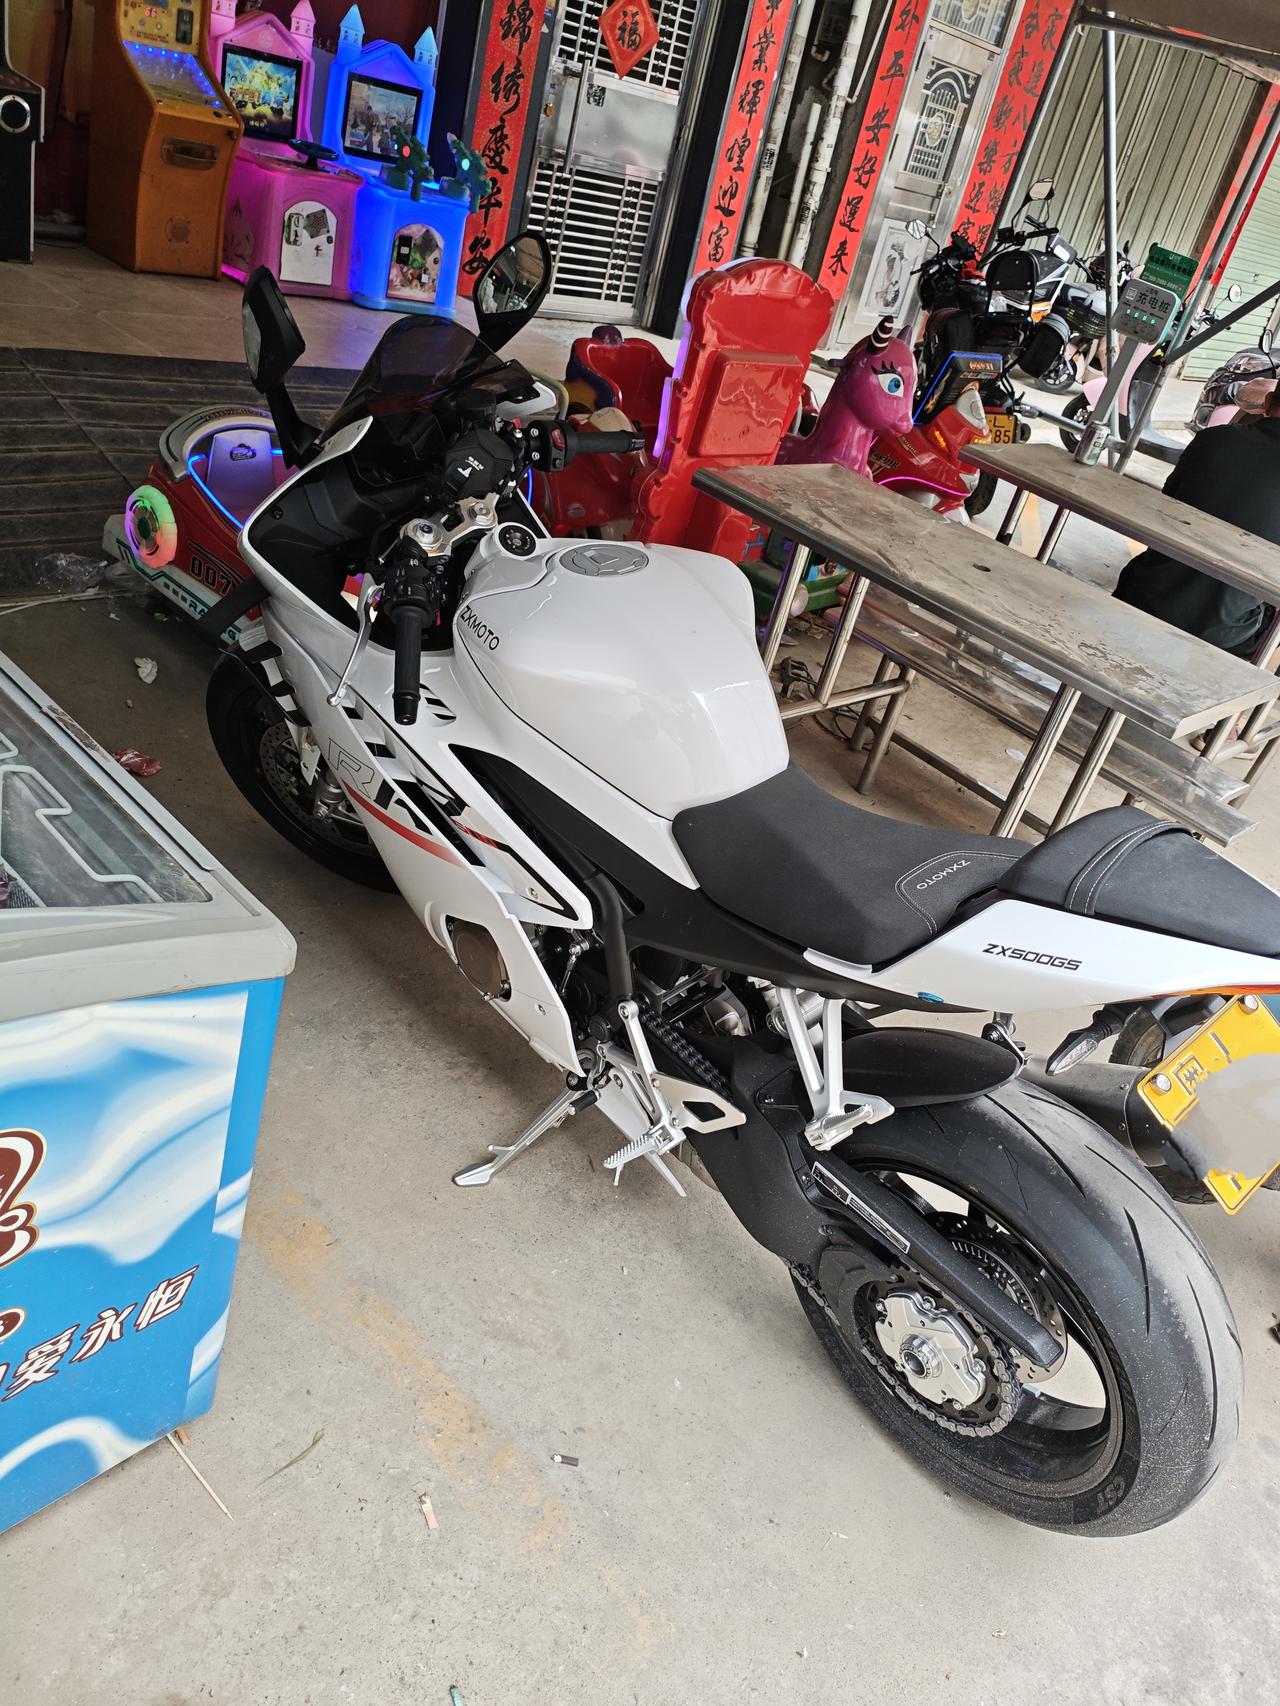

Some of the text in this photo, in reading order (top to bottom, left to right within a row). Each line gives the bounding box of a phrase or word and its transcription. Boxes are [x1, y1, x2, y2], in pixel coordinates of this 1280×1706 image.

[615, 10, 642, 51] 福
[1136, 292, 1171, 314] 充电桩
[989, 429, 1012, 444] 85
[190, 555, 233, 597] 007
[460, 605, 500, 651] ZXMOTO
[916, 859, 972, 890] ZXMOTO
[982, 943, 1083, 972] ZX500GS
